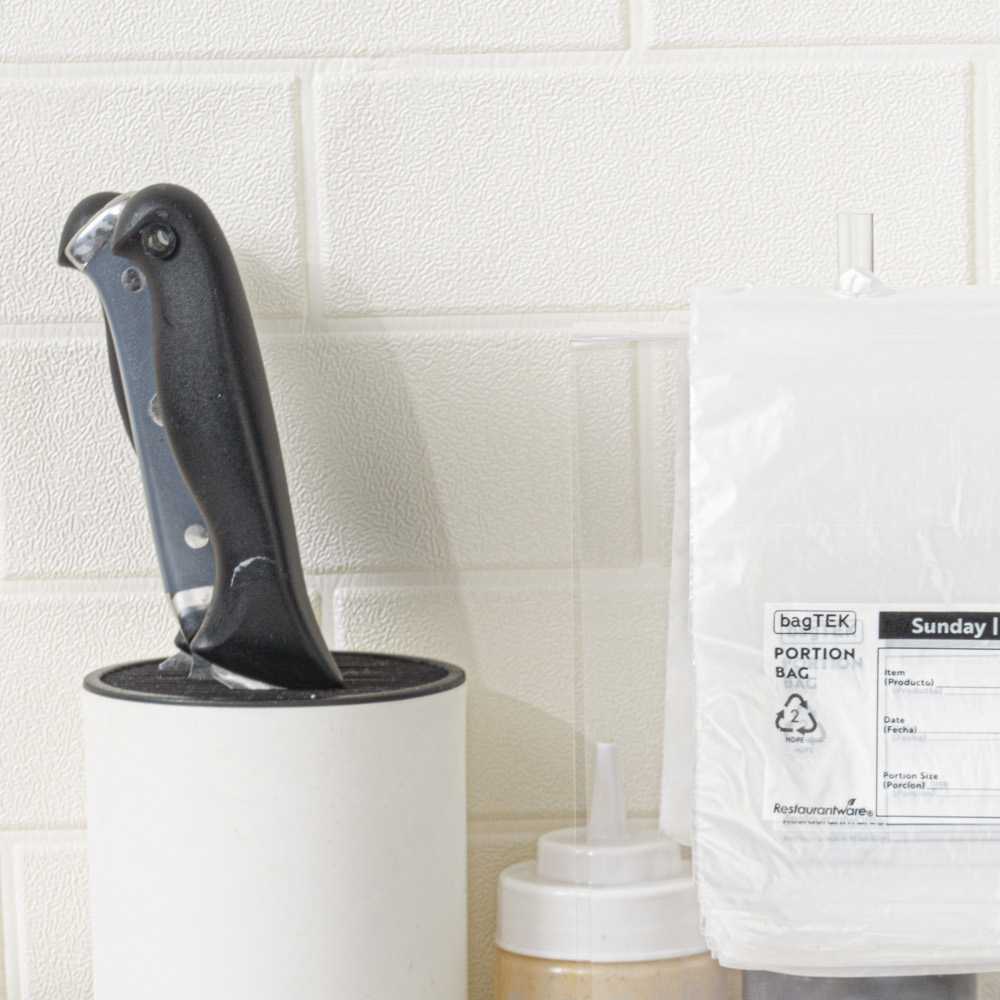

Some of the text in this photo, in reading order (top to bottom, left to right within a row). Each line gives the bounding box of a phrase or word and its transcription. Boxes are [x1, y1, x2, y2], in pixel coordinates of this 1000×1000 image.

[780, 613, 850, 631] bagTEK
[911, 617, 987, 639] Sunday
[774, 647, 856, 660] PORTION
[775, 666, 809, 679] BAG
[884, 669, 906, 677] Item
[790, 708, 800, 723] 2
[883, 716, 905, 724] Date
[883, 726, 917, 735] (Fecha)
[882, 771, 939, 780] Portion Size
